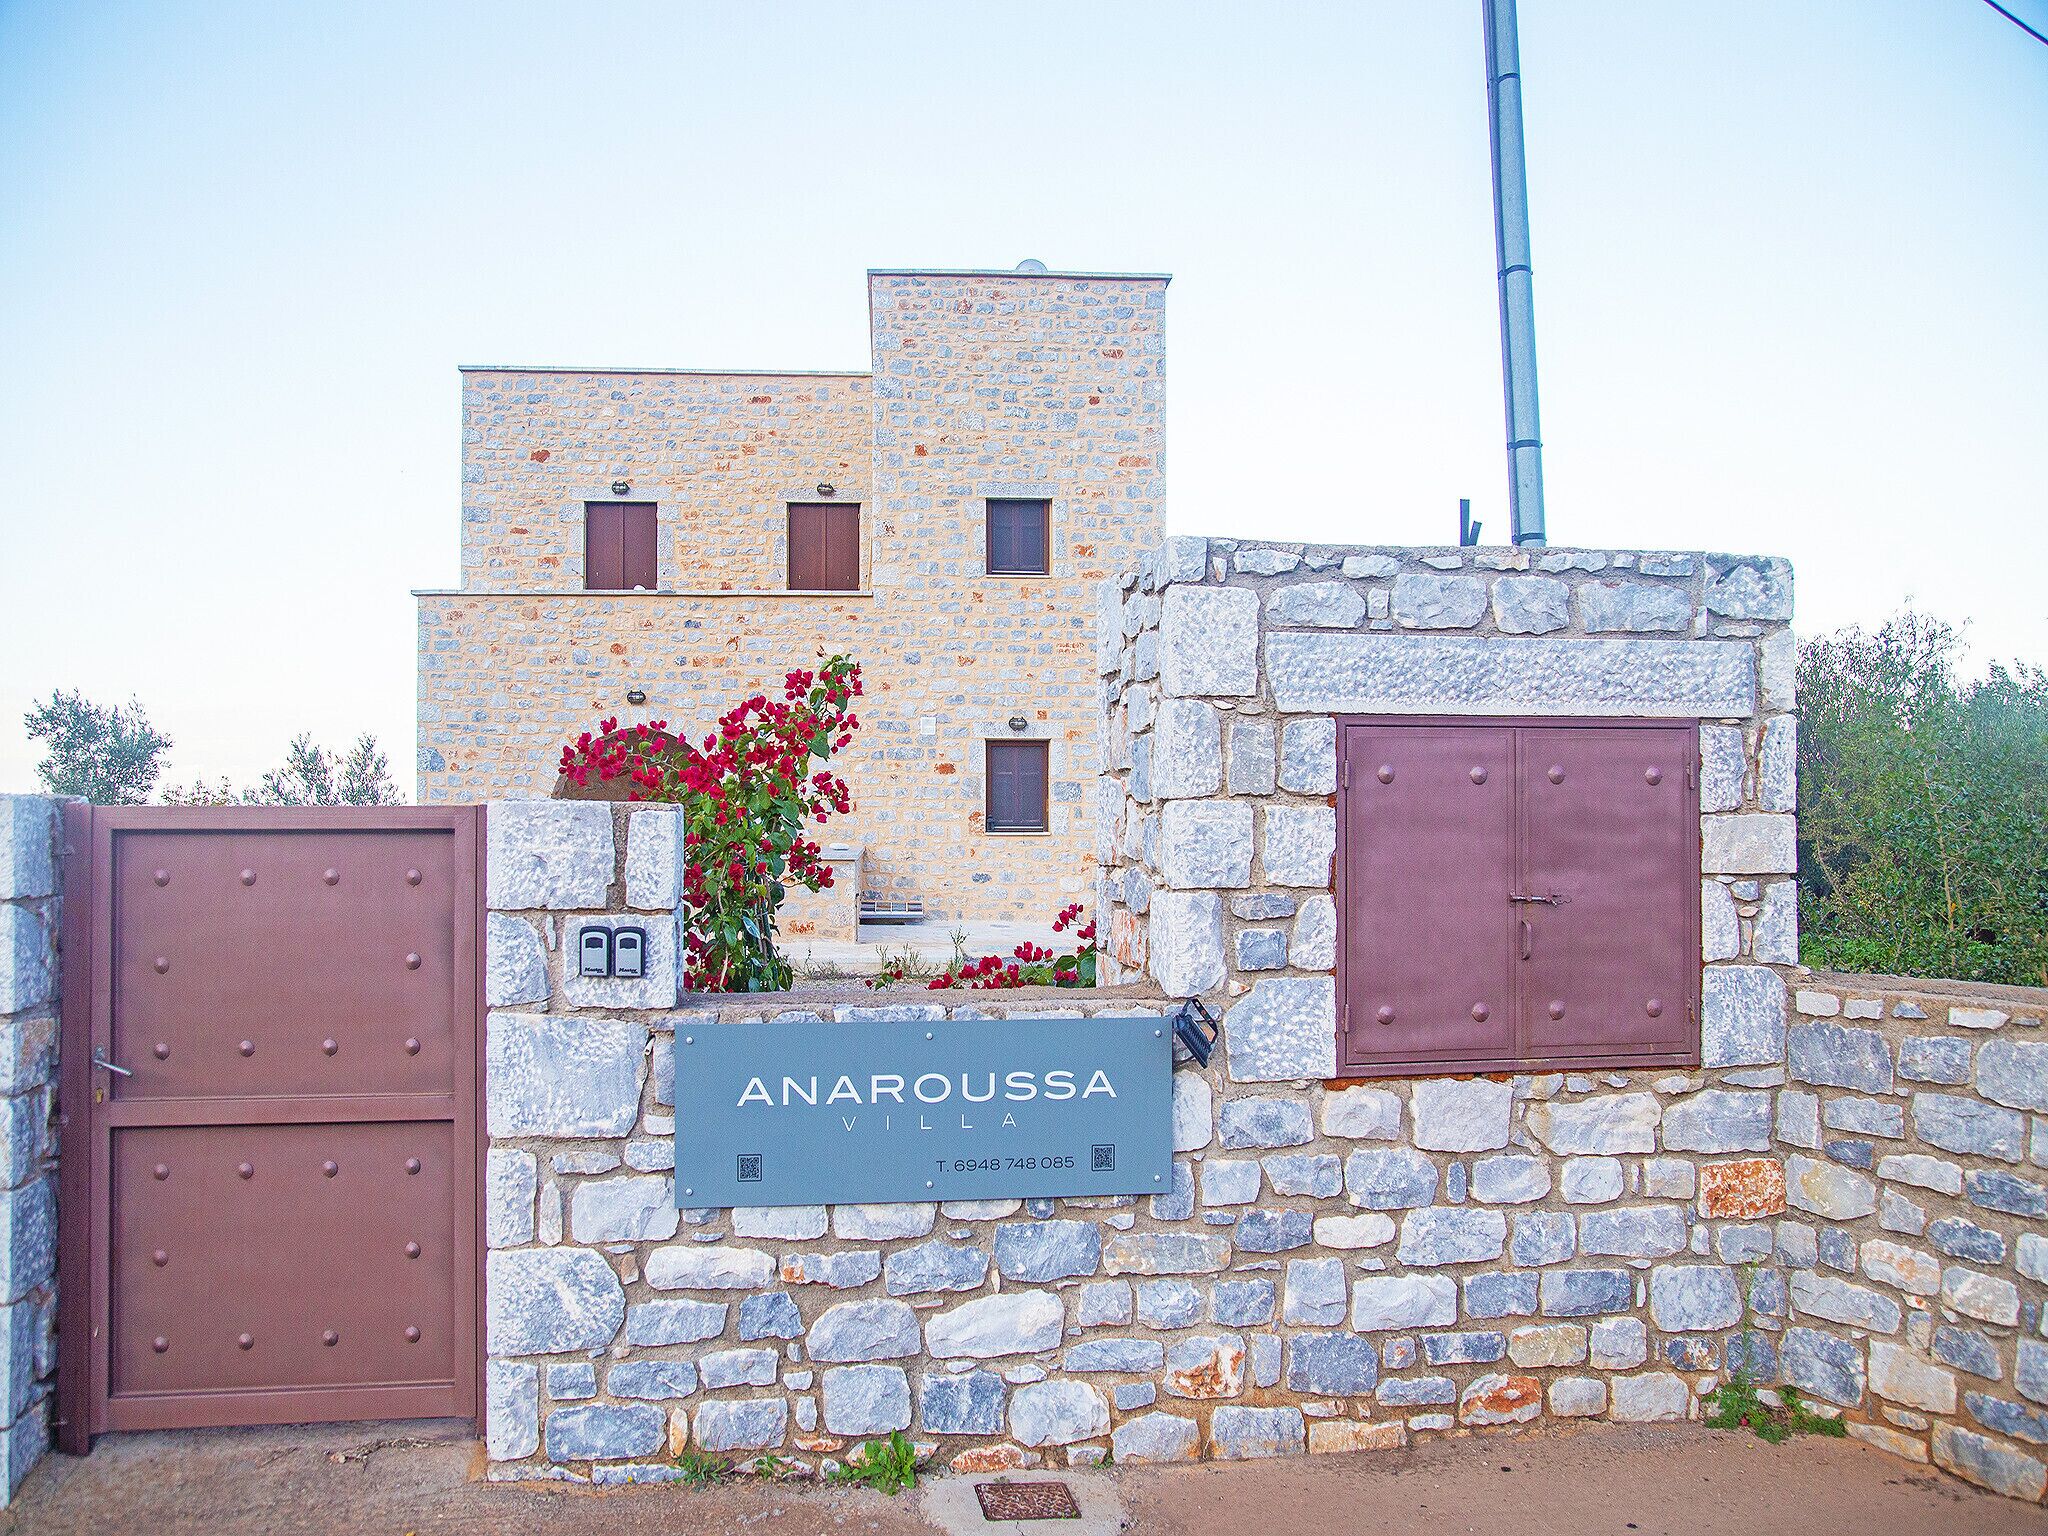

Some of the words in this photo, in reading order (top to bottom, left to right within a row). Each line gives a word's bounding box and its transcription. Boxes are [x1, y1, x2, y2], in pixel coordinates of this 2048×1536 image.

[736, 1070, 1118, 1107] ANAROUSSA
[842, 1112, 1017, 1132] VILLA
[936, 1160, 950, 1173] T.
[954, 1158, 1001, 1172] 6948
[1005, 1157, 1037, 1170] 748
[1040, 1156, 1075, 1169] 085
